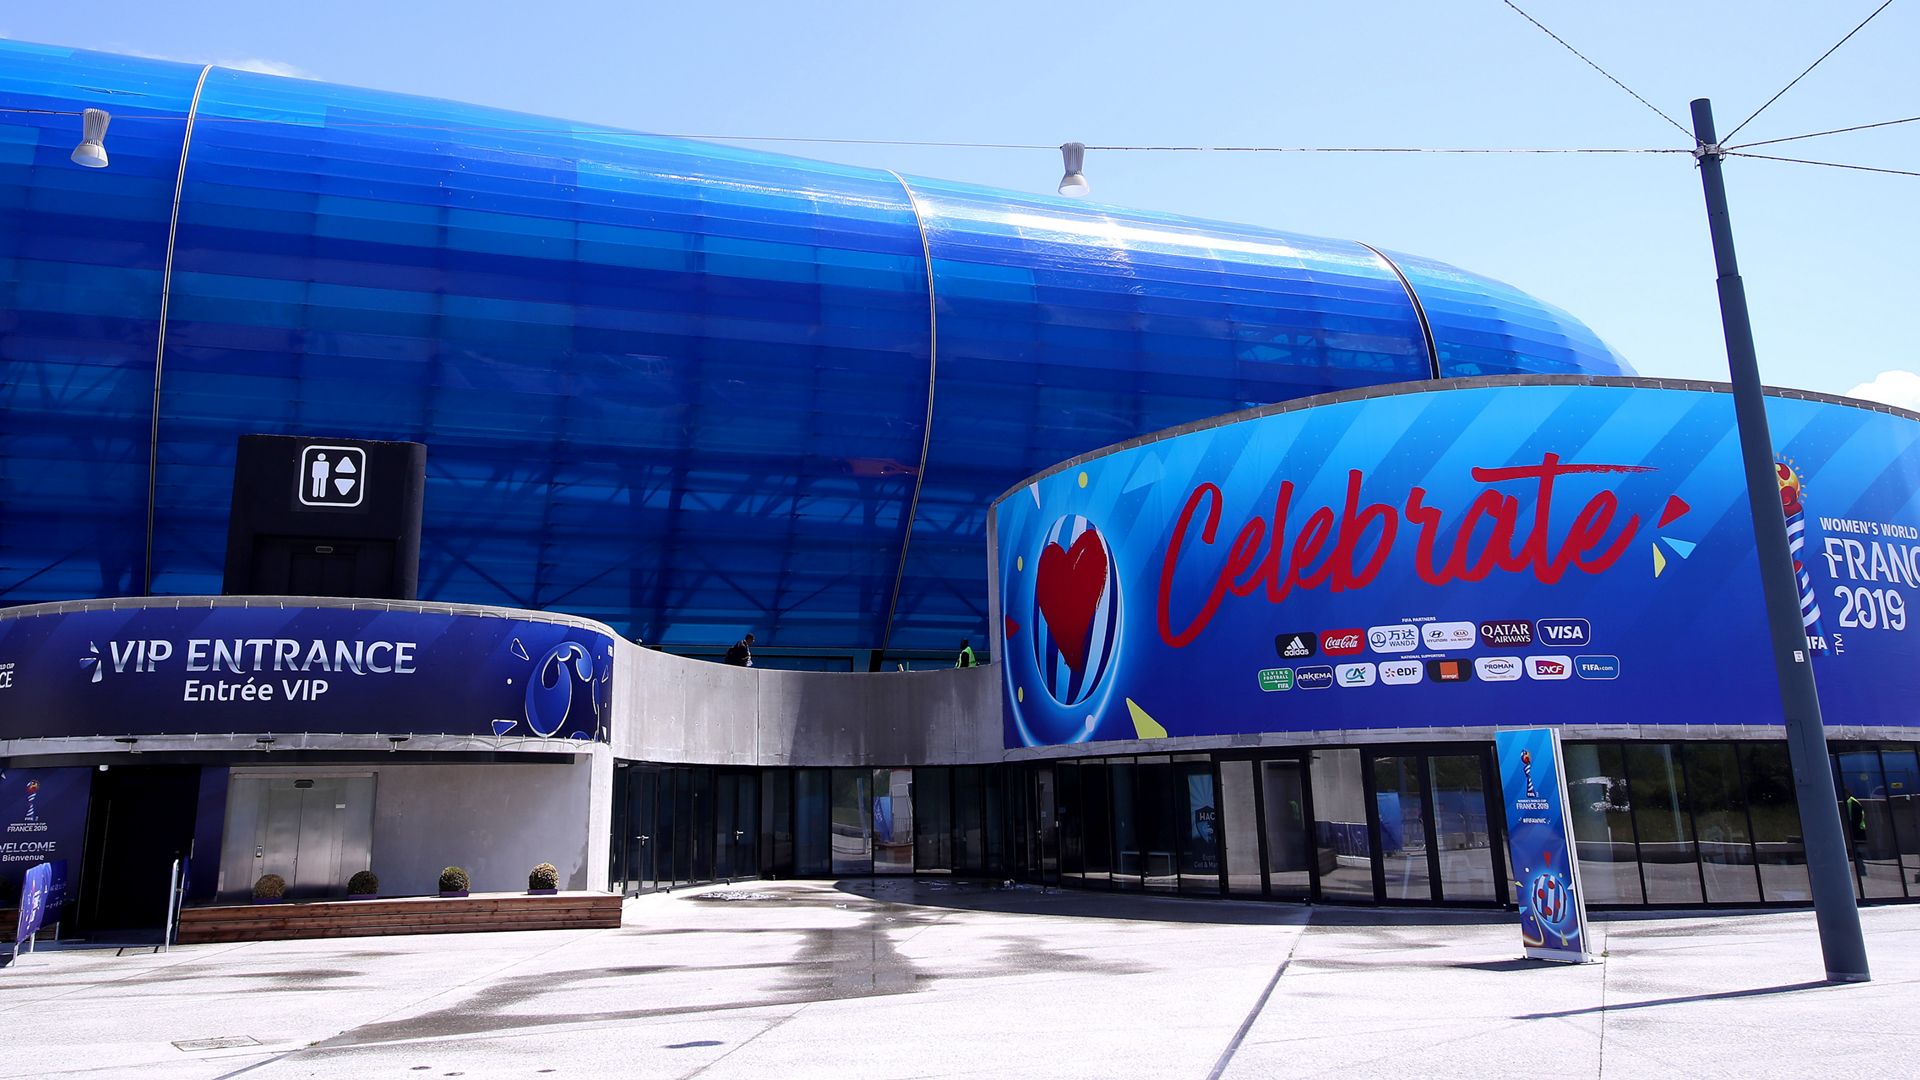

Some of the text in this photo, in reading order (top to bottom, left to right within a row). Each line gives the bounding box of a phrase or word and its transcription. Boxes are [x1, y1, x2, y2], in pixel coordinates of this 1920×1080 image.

[1819, 517, 1918, 540] WOMEN'S WORLD
[1158, 452, 1660, 648] Celebrate
[1821, 537, 1920, 588] FRANC
[1834, 585, 1906, 631] 2019
[1388, 629, 1415, 640] 万达
[1481, 623, 1530, 638] QATAR
[1544, 626, 1583, 639] VISA
[1494, 635, 1531, 644] AIRWAYS
[1806, 636, 1828, 650] IFA
[110, 639, 417, 675] VIP ENTRANCE
[1284, 648, 1309, 657] adidas
[1538, 665, 1563, 674] SNCF
[1298, 672, 1332, 681] ARKEMA
[183, 677, 328, 701] Entrée VIP
[1199, 812, 1216, 821] HAC
[2, 854, 45, 862] Bienvenue
